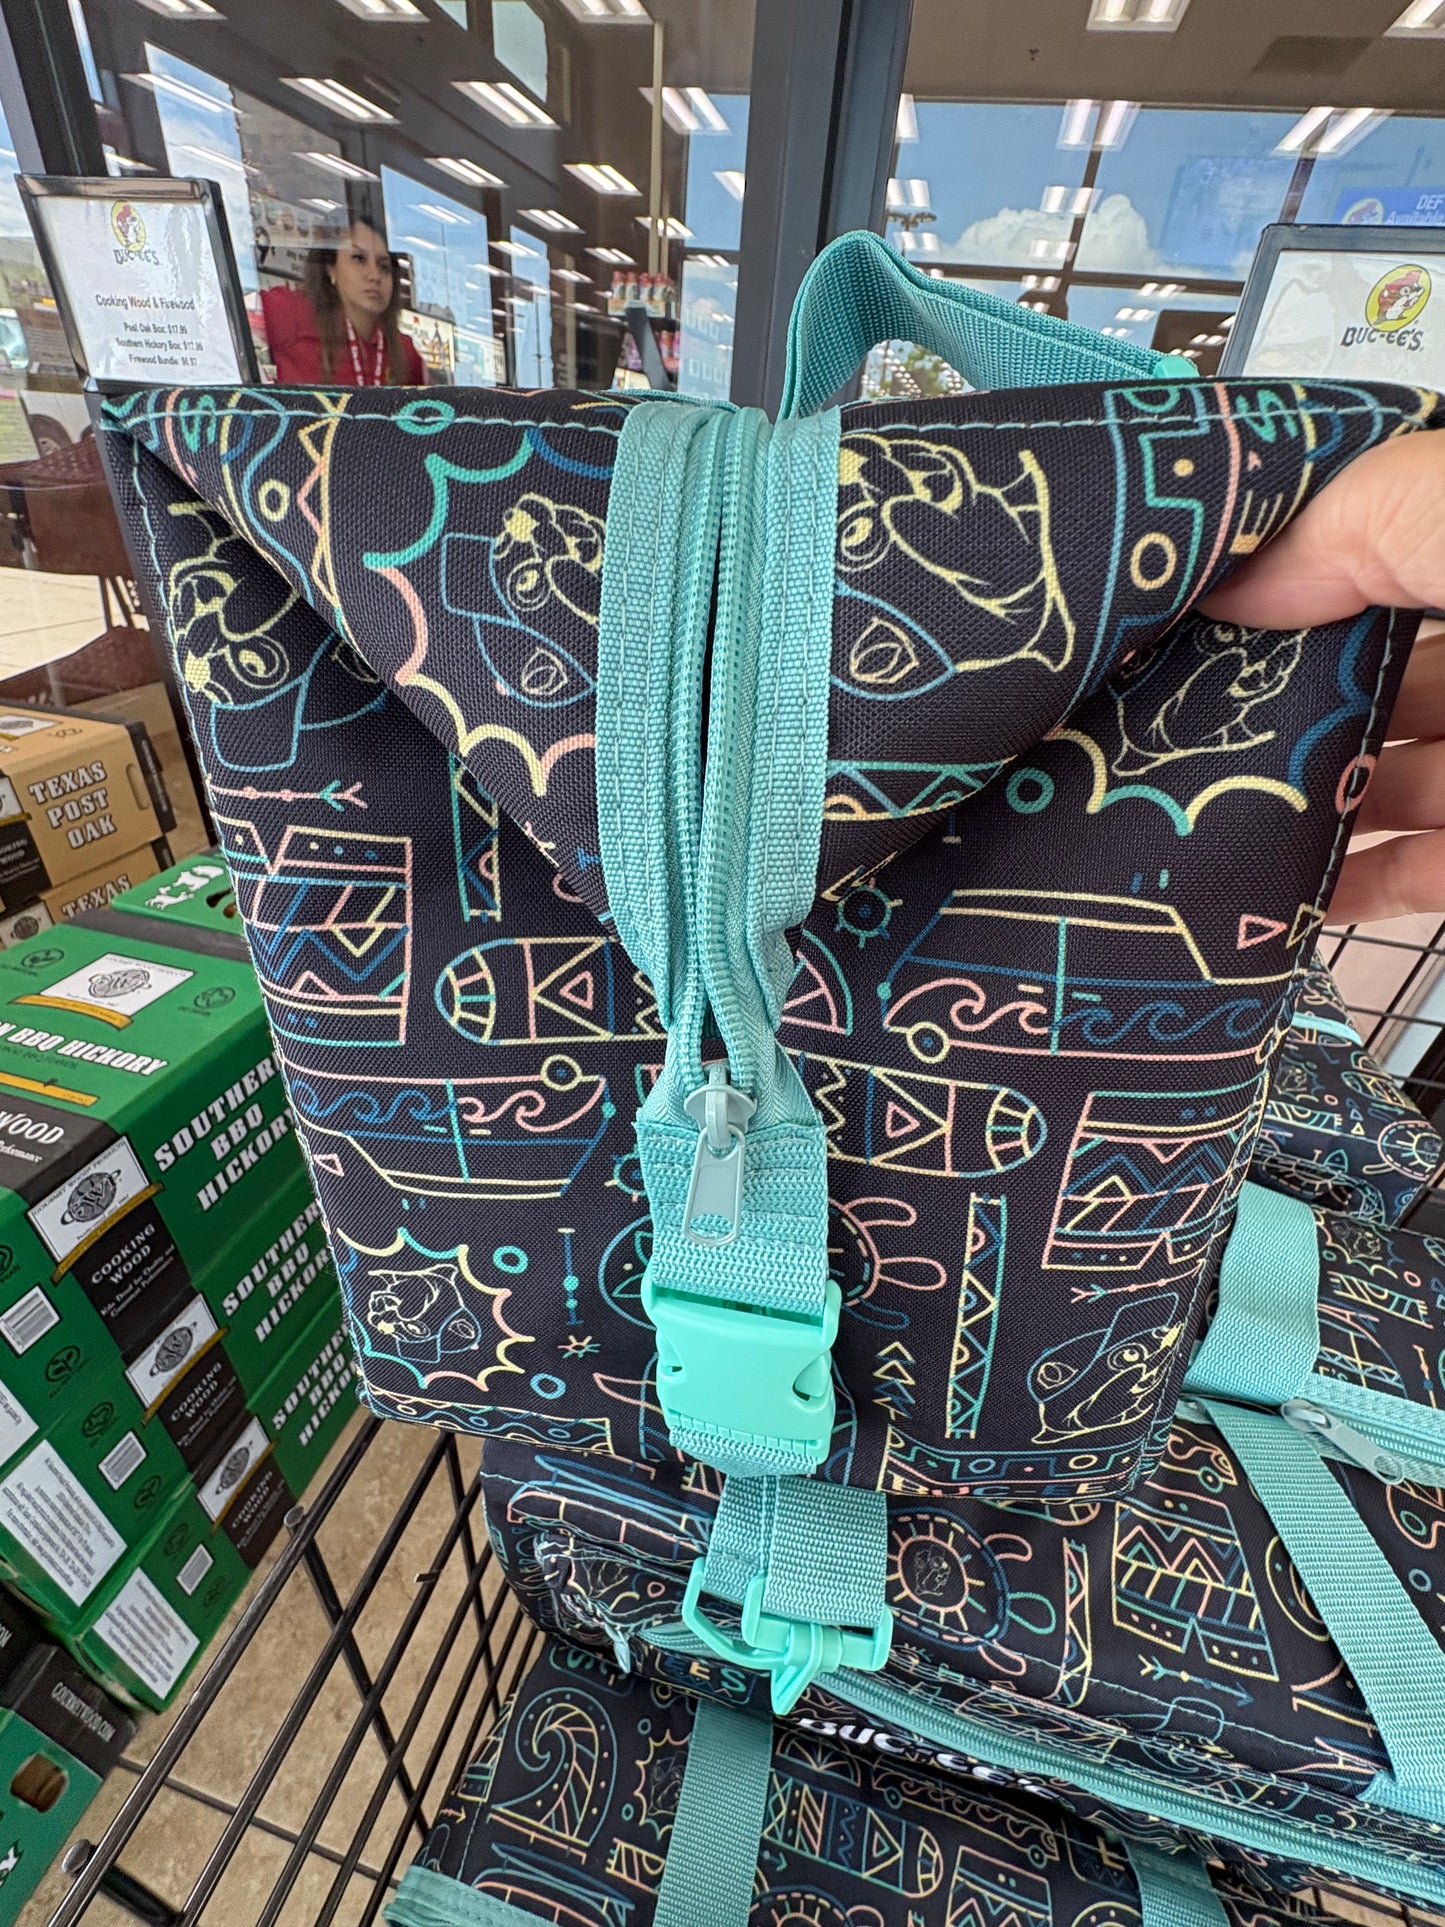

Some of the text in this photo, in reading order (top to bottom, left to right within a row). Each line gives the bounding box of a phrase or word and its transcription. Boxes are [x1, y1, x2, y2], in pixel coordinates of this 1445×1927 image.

[1416, 194, 1445, 210] DEF
[95, 294, 196, 311] Cooking Wood & Firewood
[115, 337, 144, 348] Southern
[144, 339, 168, 352] Hickory
[123, 322, 139, 334] Post
[139, 323, 152, 334] Oak
[1340, 326, 1424, 352] BUC-EE'S
[129, 354, 157, 366] Firewood
[28, 761, 108, 804] TEXAS
[46, 788, 109, 830] POST
[66, 814, 117, 849] OAK
[61, 874, 132, 919] TEXAS
[7, 1027, 65, 1052] BBQ
[57, 1039, 169, 1077] HICKORY
[210, 1103, 264, 1161] BBQ
[91, 1223, 156, 1284] COOKING
[109, 1244, 151, 1284] WOOD
[222, 1200, 322, 1317] SOUTHER
[266, 1242, 310, 1298] BBQ
[254, 1246, 330, 1344] HICKOR
[171, 1362, 222, 1422] COOKING
[185, 1380, 218, 1419] WOOD
